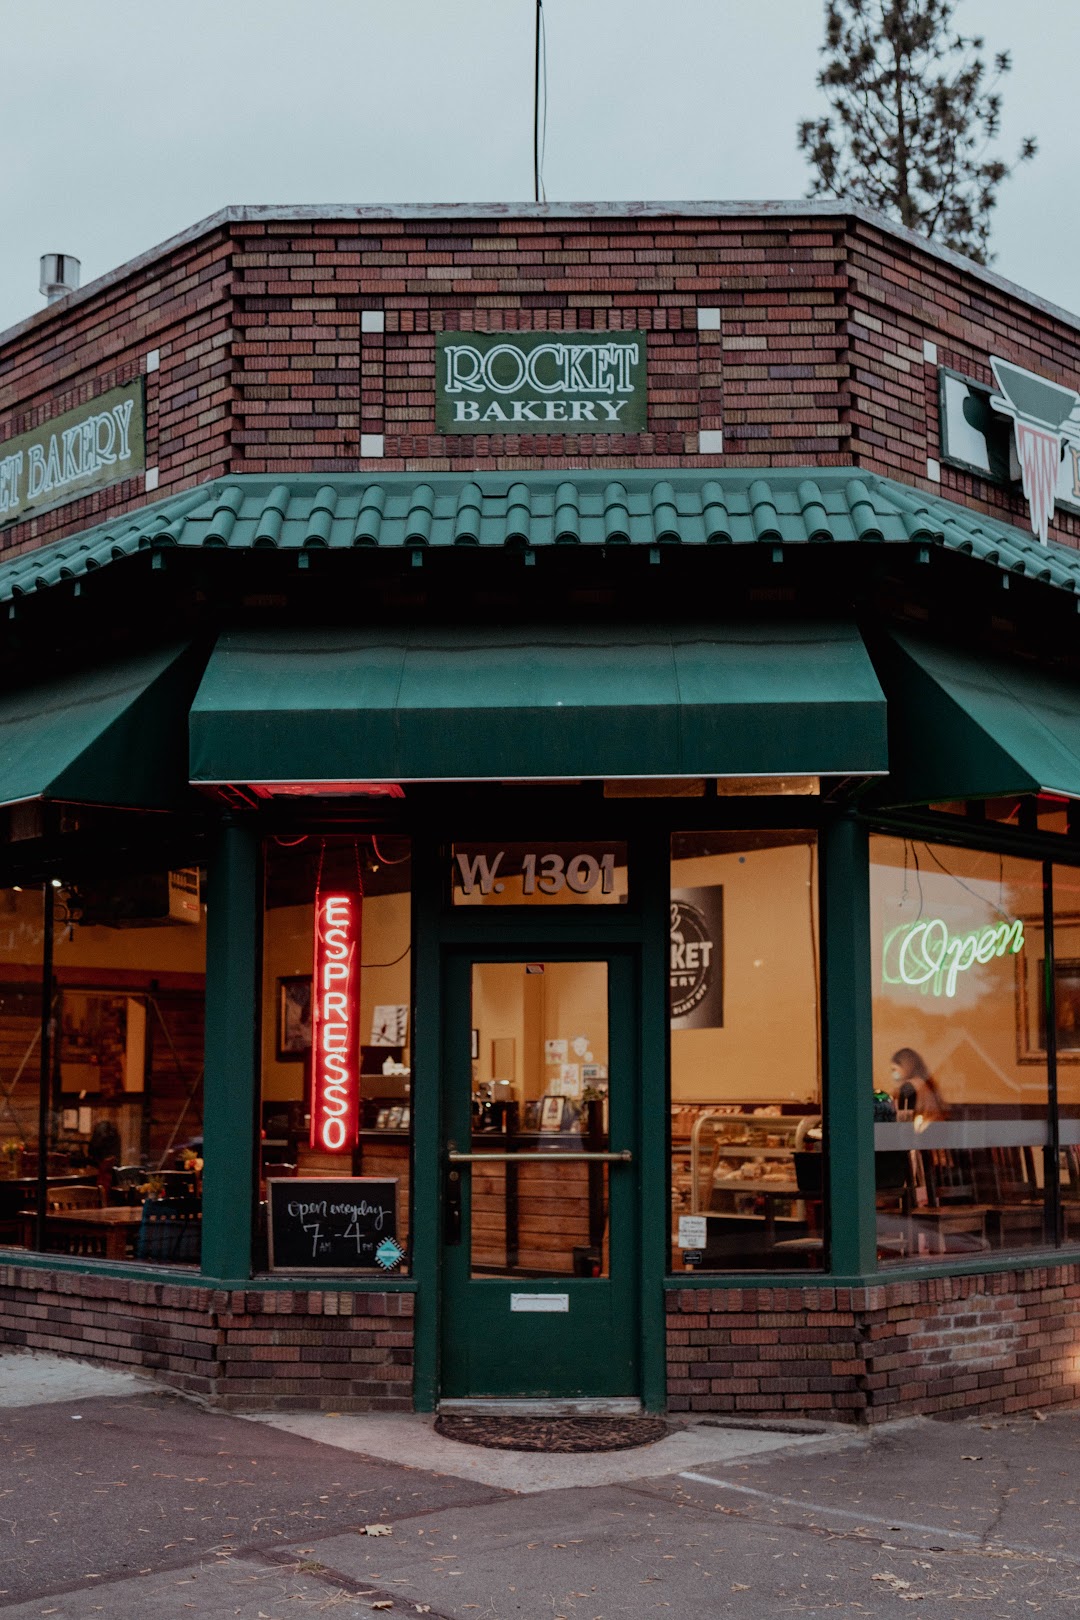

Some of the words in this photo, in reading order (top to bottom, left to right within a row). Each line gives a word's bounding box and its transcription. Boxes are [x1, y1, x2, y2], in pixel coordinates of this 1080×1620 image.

[444, 342, 639, 394] ROCKET
[453, 400, 628, 422] BAKERY
[27, 400, 134, 500] BAKERY
[455, 851, 505, 895] W.
[522, 853, 615, 895] 1301
[899, 919, 1025, 998] Open
[322, 897, 350, 1149] ESPRESSO
[303, 1223, 324, 1258] 7
[343, 1222, 366, 1254] 4
